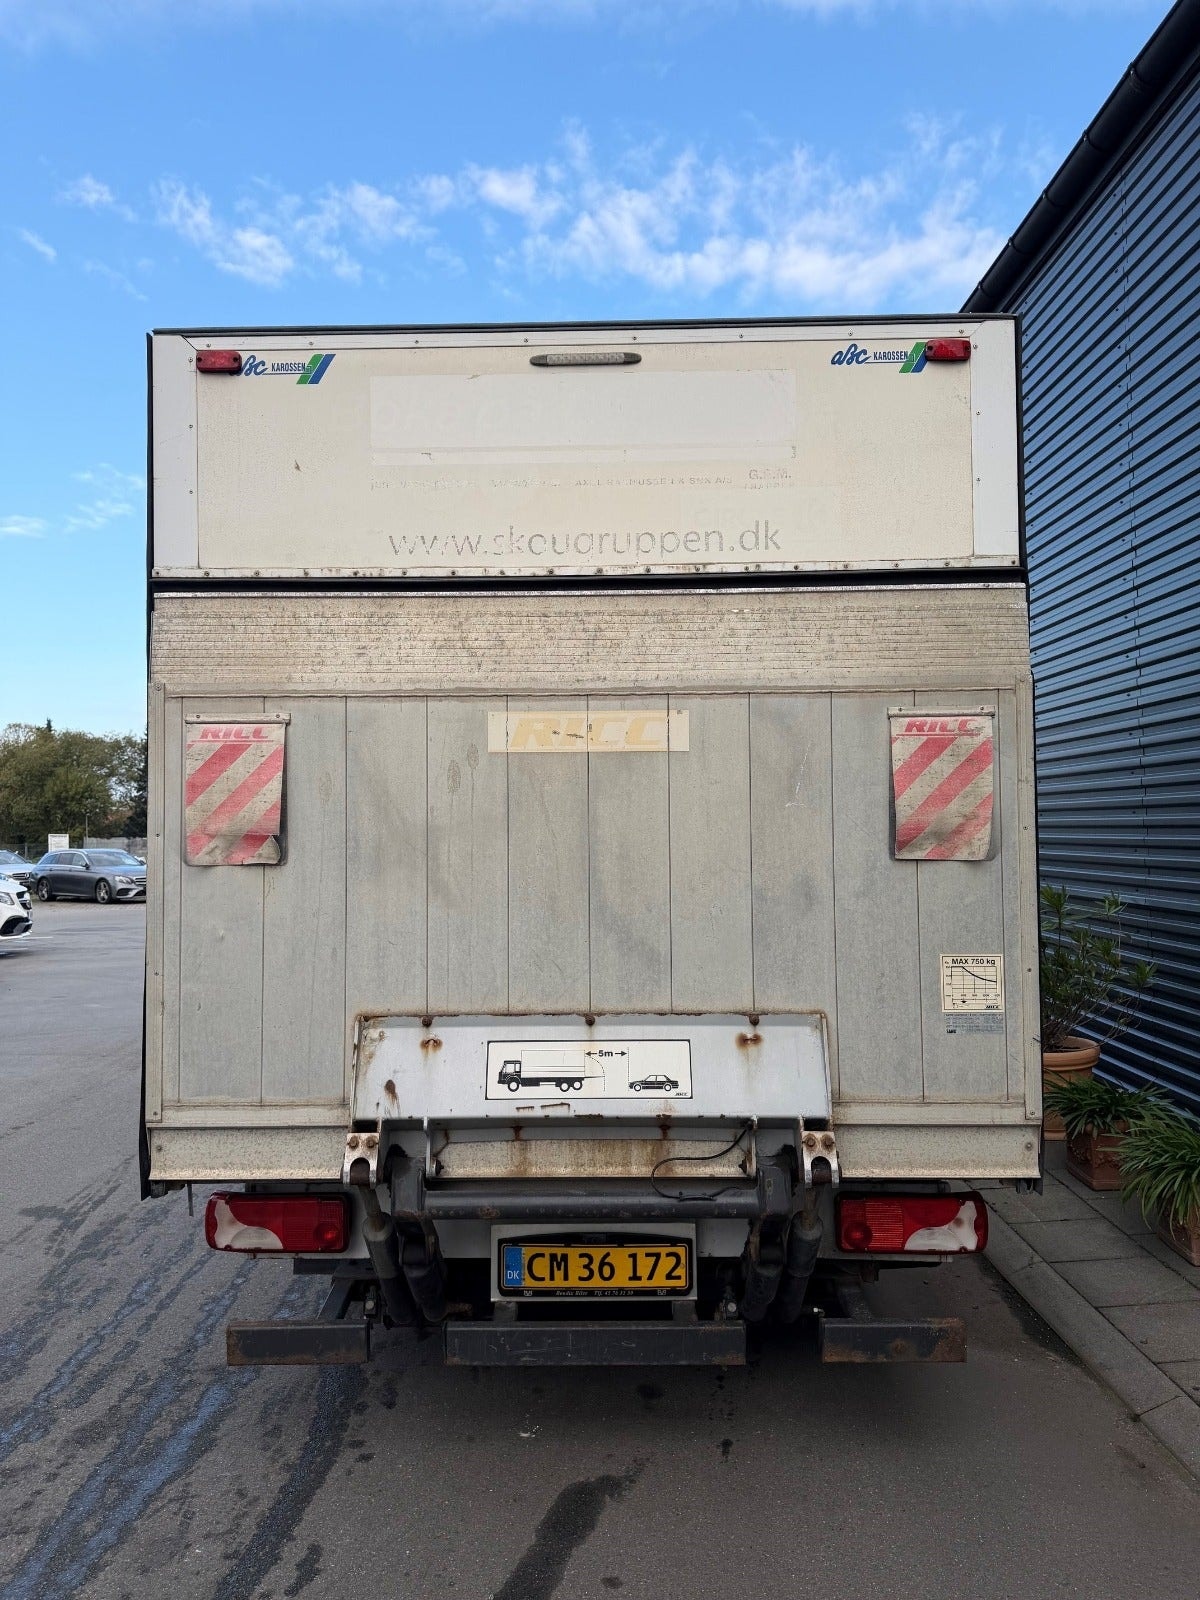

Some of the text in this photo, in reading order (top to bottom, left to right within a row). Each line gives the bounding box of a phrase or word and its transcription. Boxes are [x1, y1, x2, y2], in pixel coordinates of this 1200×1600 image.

[873, 350, 908, 361] KAROSSEN
[271, 362, 306, 373] KAROSSEN
[509, 717, 664, 747] RICC
[986, 958, 996, 966] kg
[598, 1049, 614, 1058] 5m
[526, 1251, 682, 1282] CM 36 172
[507, 1270, 520, 1280] DK
